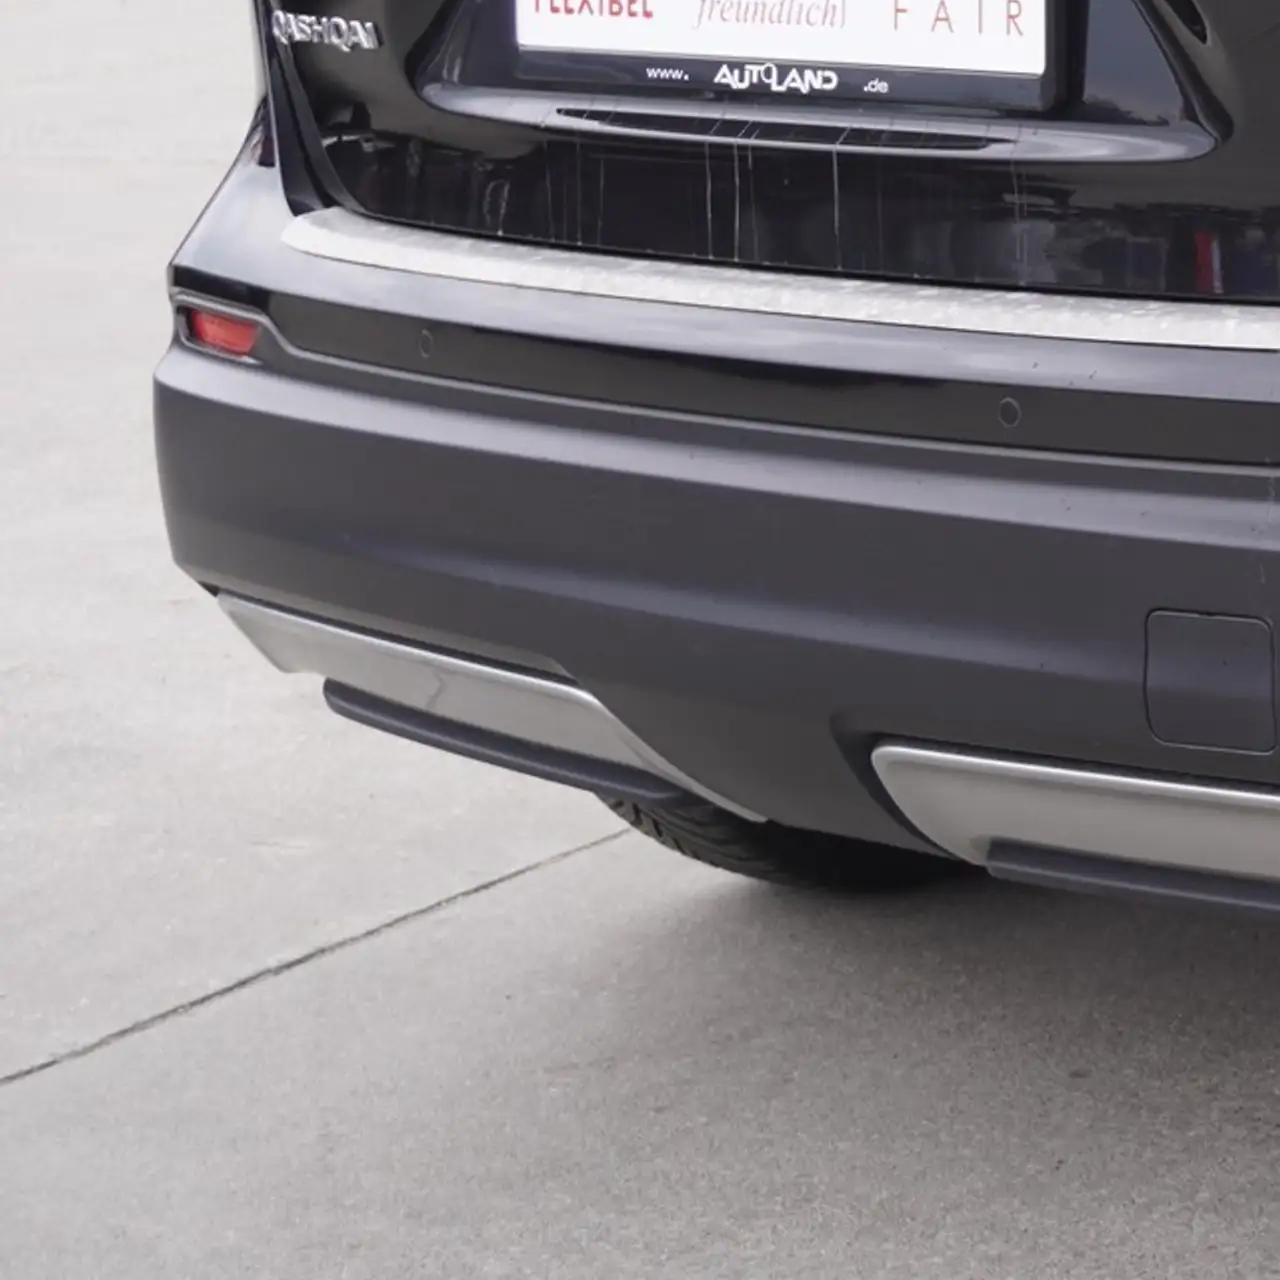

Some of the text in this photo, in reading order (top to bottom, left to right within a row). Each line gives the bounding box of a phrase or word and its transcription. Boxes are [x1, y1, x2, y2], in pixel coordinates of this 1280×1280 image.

[272, 10, 377, 52] QASHQAI
[646, 63, 889, 94] www. AUTOLAND .de
